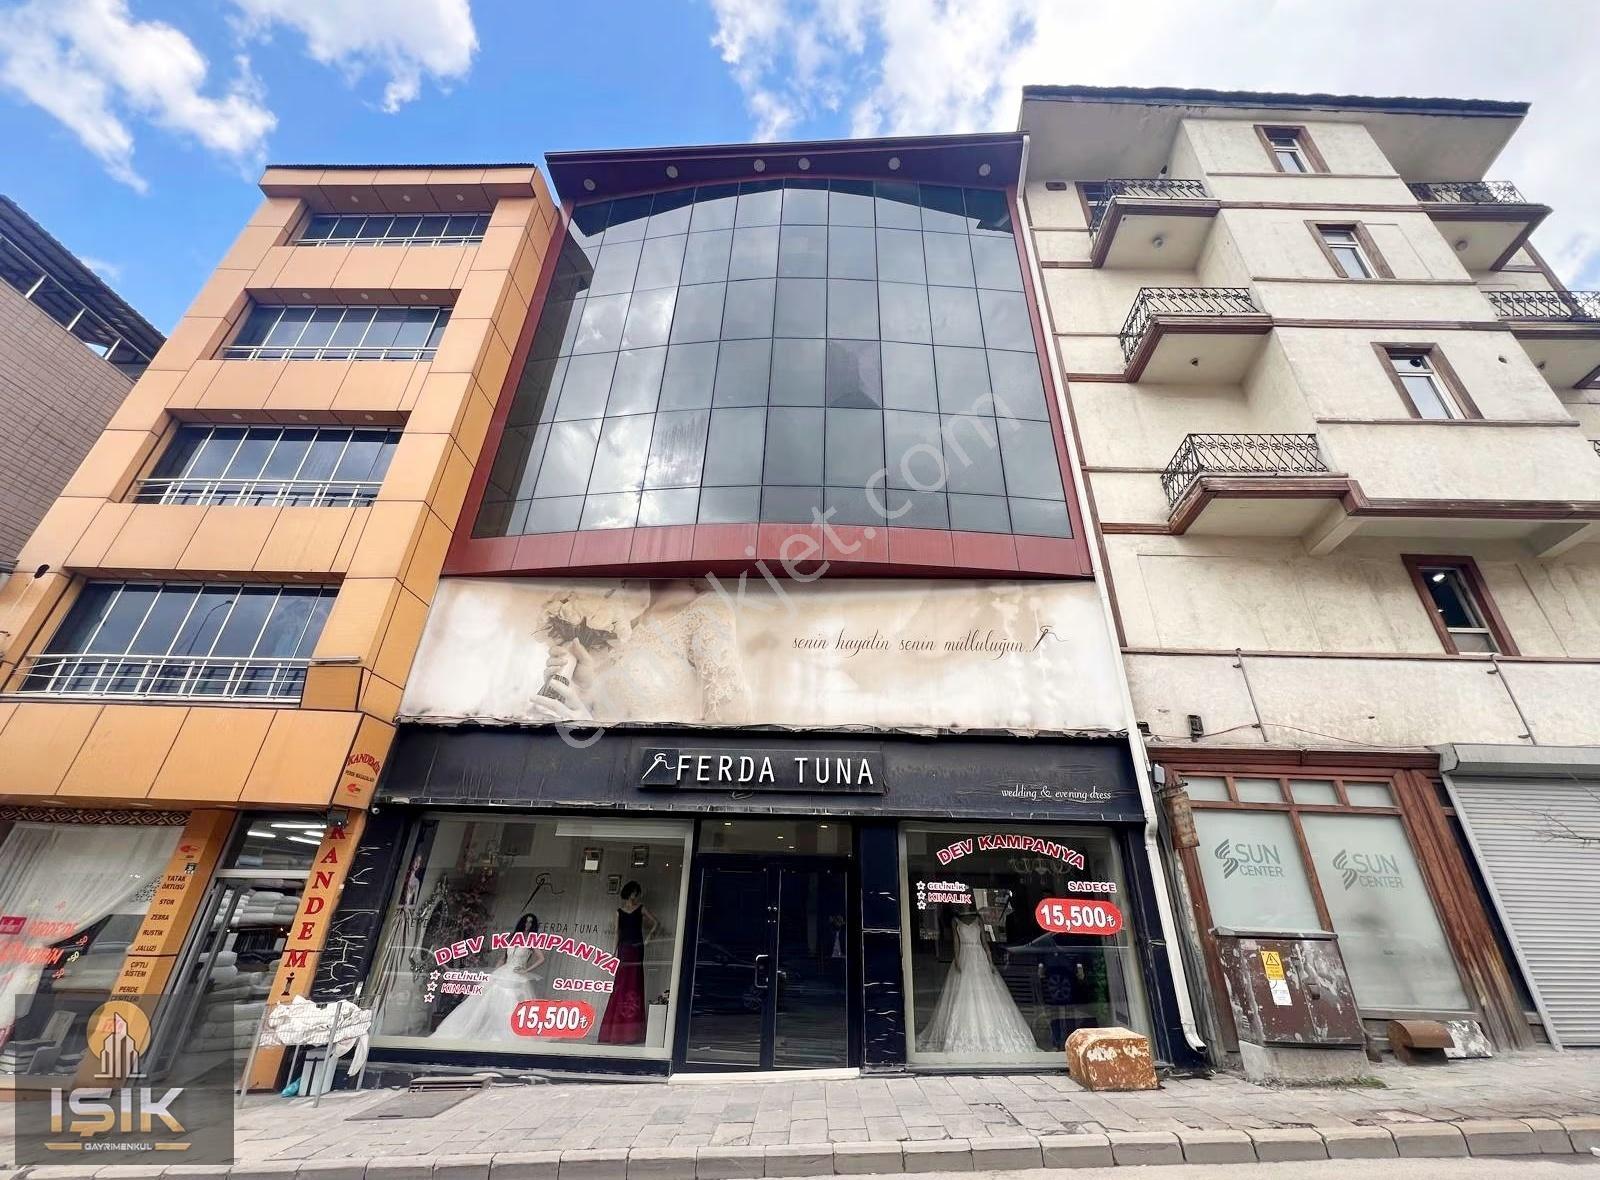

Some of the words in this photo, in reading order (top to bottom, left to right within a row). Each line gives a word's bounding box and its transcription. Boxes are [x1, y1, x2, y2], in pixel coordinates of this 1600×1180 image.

[792, 632, 828, 650] senin
[899, 635, 936, 651] senin
[676, 755, 775, 783] FERDA
[794, 757, 874, 785] TUNA
[1001, 783, 1037, 801] wedding
[1040, 785, 1051, 798] &
[1055, 788, 1088, 801] evening
[1089, 785, 1112, 800] dress
[936, 839, 973, 866] DEV
[978, 834, 1085, 870] KAMPANYA
[1235, 843, 1281, 865] SUN
[1240, 866, 1284, 878] CENTER
[1353, 853, 1400, 875] SUN
[1068, 881, 1117, 893] SADECE
[1359, 875, 1404, 889] CENTER
[927, 892, 972, 904] KINALIK
[434, 936, 485, 965] DEV
[491, 931, 621, 976] KAMPANYA
[440, 982, 484, 996] KINALIK
[552, 978, 614, 993] SADECE
